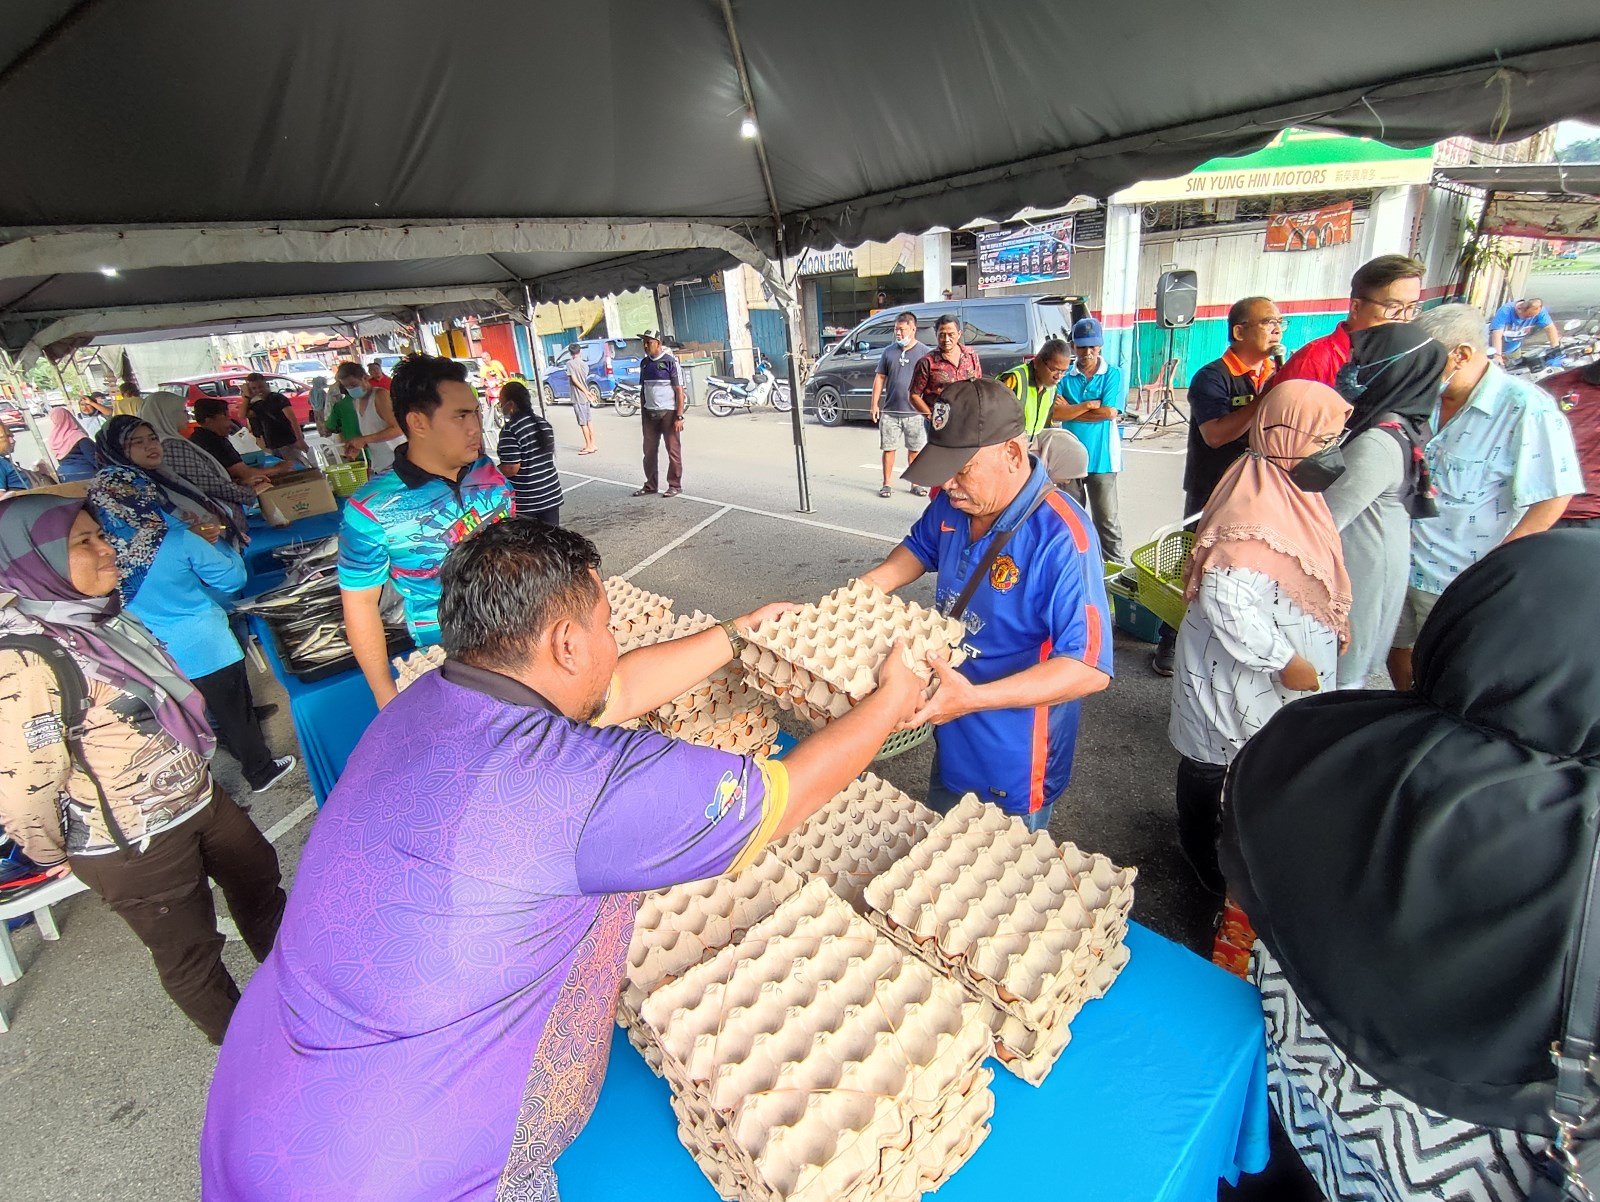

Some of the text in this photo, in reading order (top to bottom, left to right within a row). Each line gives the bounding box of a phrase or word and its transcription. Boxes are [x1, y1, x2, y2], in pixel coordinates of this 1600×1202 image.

[1186, 169, 1328, 193] SIN YUNG HIN MOTORS
[828, 250, 854, 273] HENG
